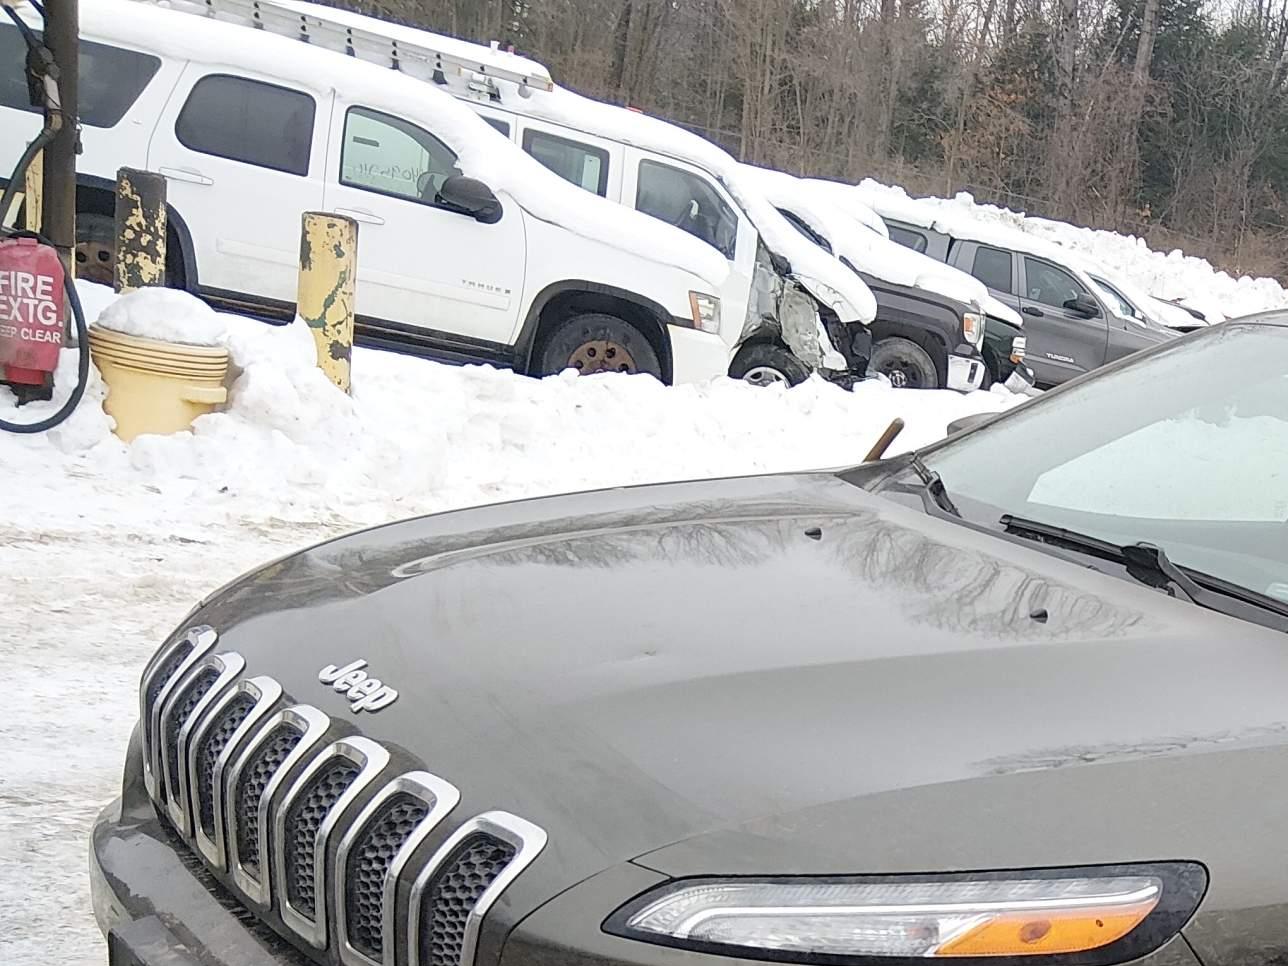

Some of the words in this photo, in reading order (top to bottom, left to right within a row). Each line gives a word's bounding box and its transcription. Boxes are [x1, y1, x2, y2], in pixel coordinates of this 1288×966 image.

[0, 271, 54, 301] FIRE
[0, 295, 64, 327] EXTG.
[0, 325, 17, 338] EEP
[21, 327, 61, 344] CLEAR
[319, 659, 399, 714] Jeep
